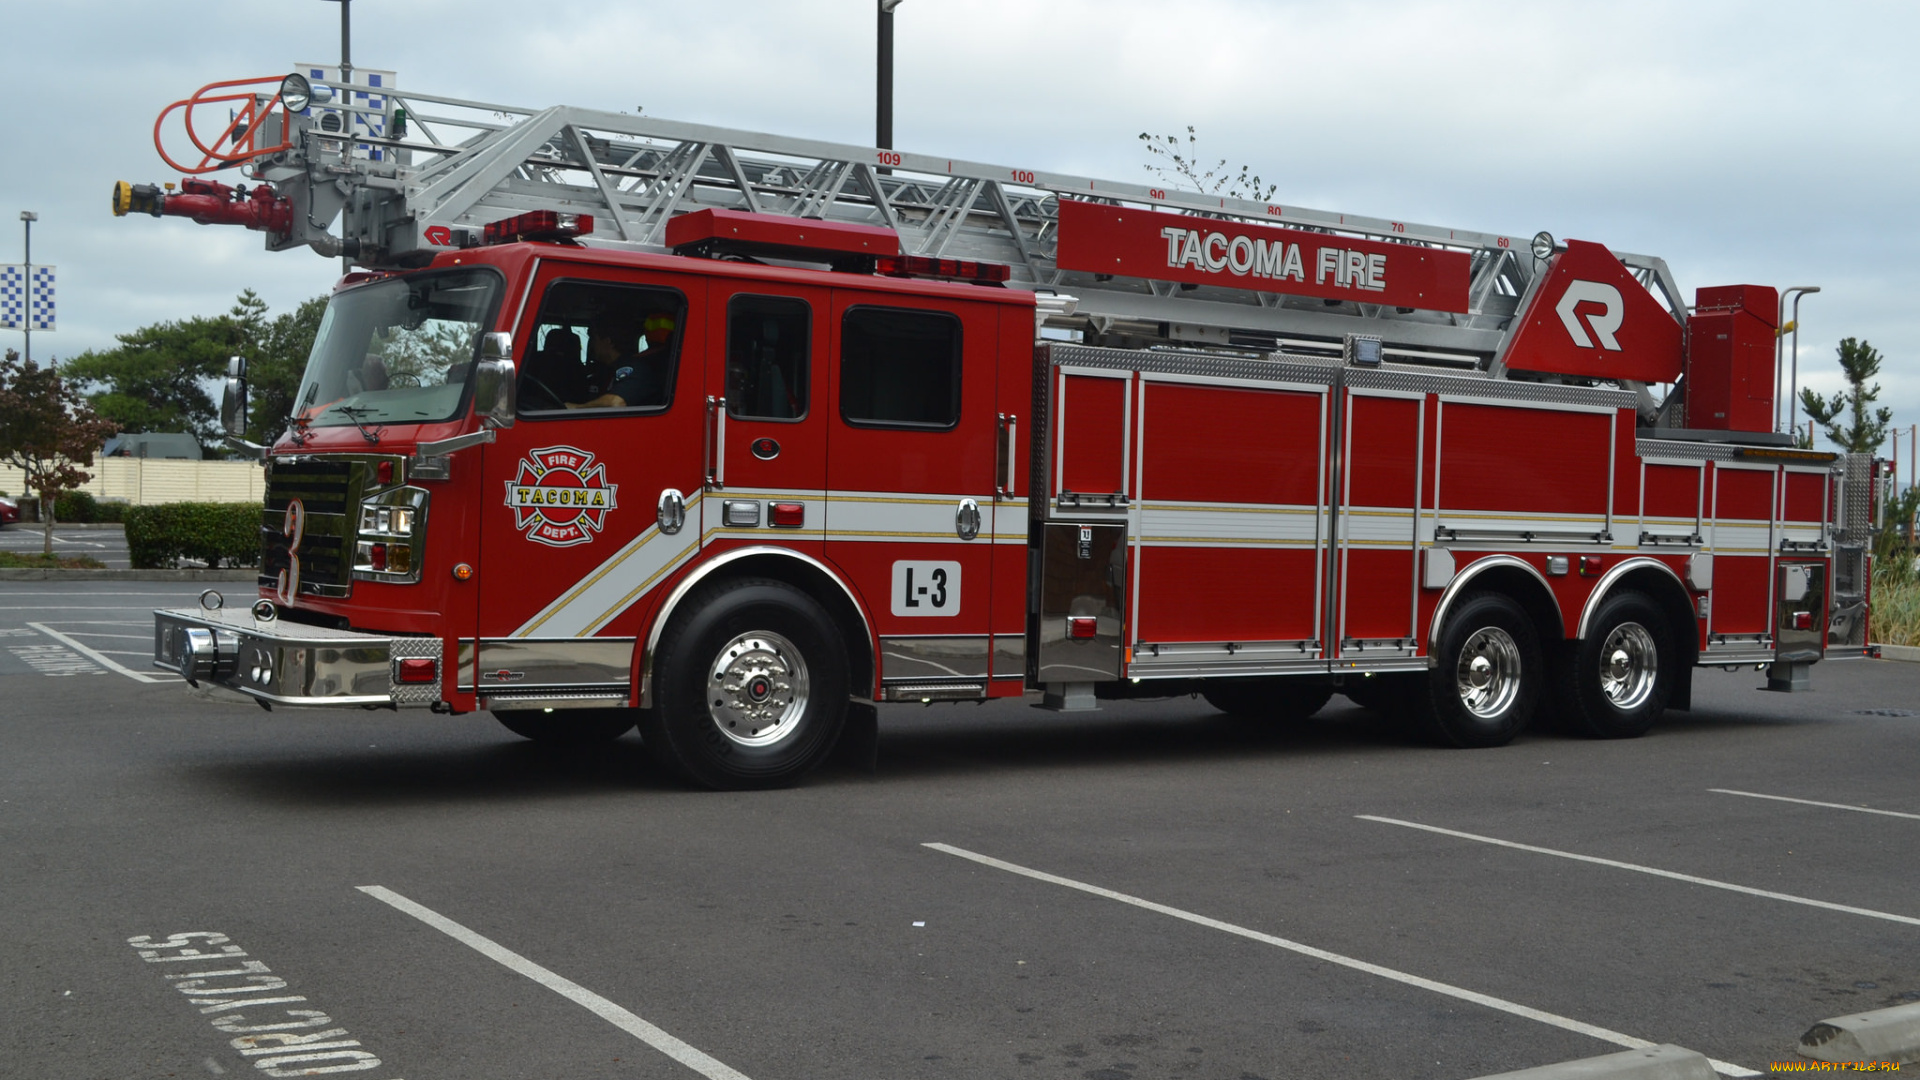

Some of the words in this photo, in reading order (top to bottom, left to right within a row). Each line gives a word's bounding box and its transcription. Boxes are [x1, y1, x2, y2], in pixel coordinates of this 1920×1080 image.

[877, 152, 901, 166] 109
[1011, 170, 1034, 183] 100
[1150, 189, 1165, 200] 90
[1267, 205, 1282, 216] 80
[1391, 222, 1405, 233] 70
[1497, 237, 1509, 248] 60
[1161, 226, 1305, 282] TACOMA
[1316, 246, 1387, 292] FIRE
[1555, 279, 1625, 352] R
[548, 454, 577, 467] FIRE
[518, 488, 605, 506] TACOMA
[542, 525, 579, 539] DEPT.
[277, 497, 305, 608] 3
[905, 567, 947, 608] L-3
